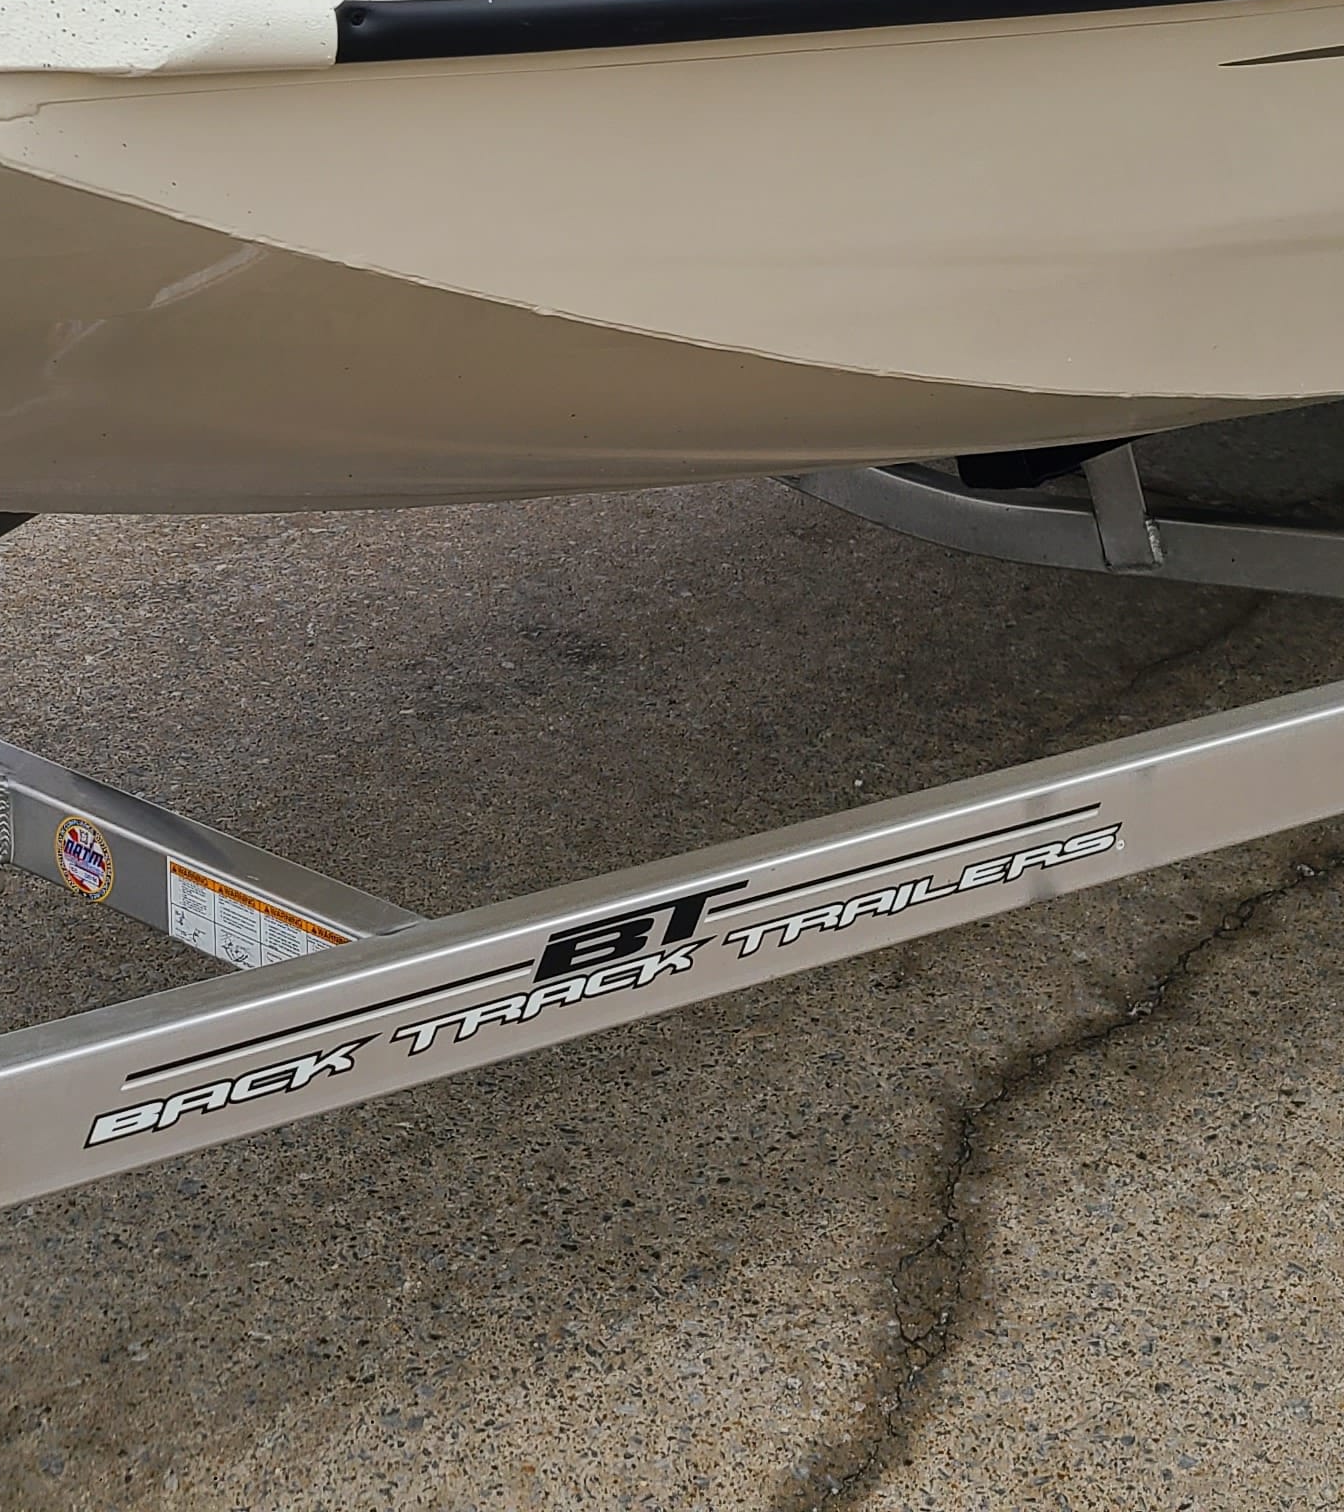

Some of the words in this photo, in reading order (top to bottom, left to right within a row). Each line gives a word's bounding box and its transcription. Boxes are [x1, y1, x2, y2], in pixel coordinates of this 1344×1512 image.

[84, 1033, 382, 1149] BACK
[390, 935, 717, 1056] TRACK
[722, 822, 1123, 959] TRAILERS
[533, 880, 749, 983] BT
